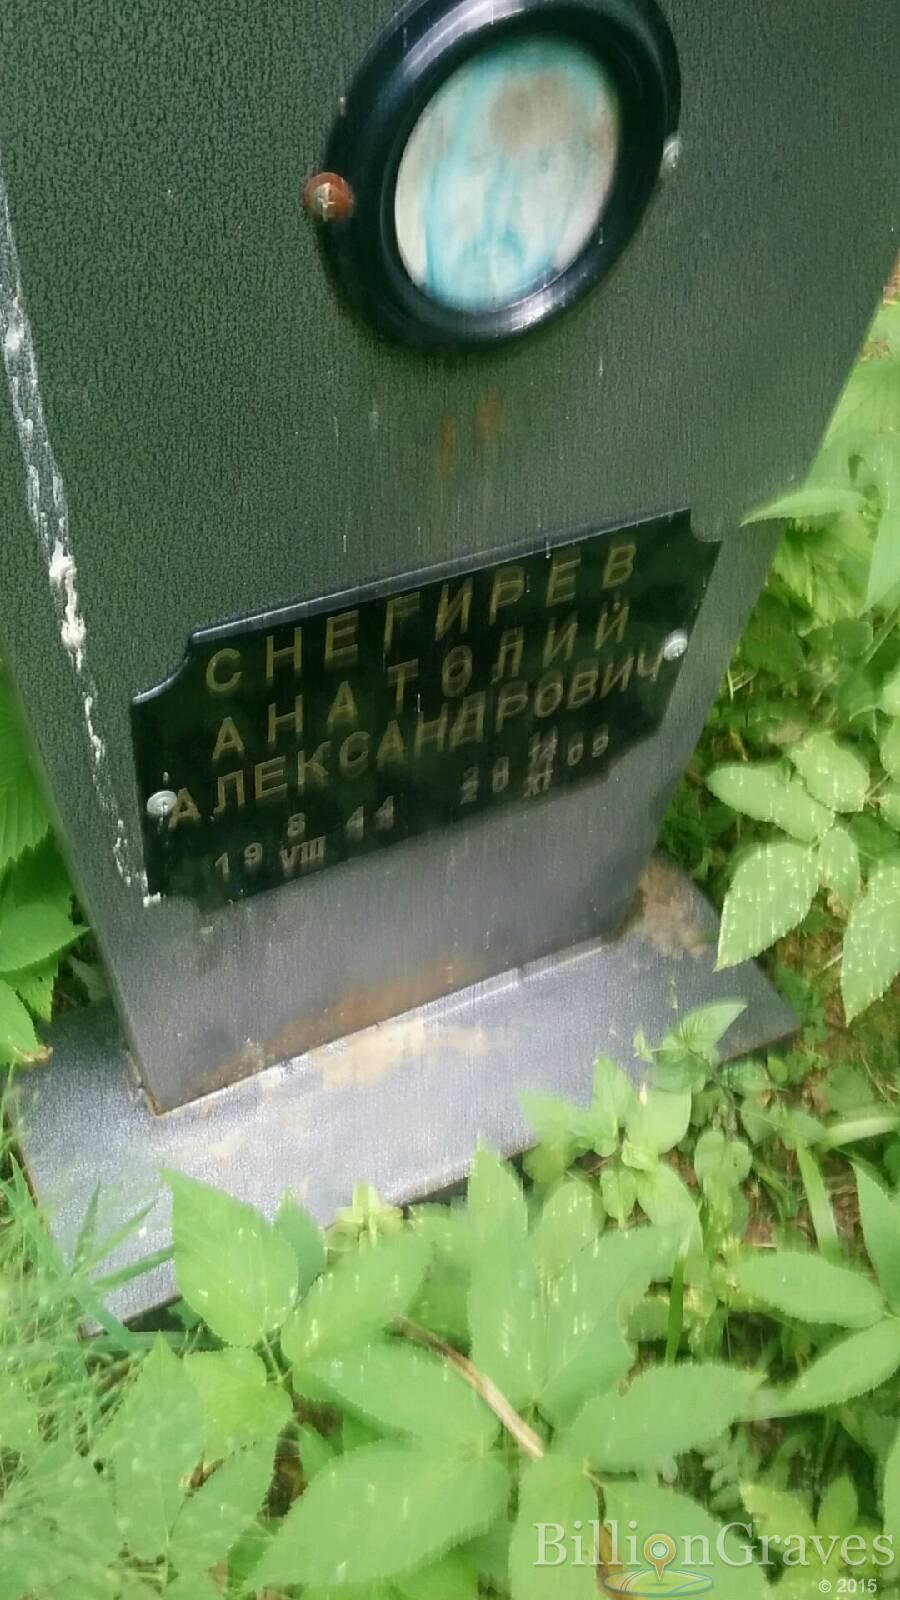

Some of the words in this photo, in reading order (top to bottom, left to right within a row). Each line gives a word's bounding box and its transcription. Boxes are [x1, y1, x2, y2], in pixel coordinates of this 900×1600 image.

[206, 540, 636, 693] СНЕГИРЕВ
[212, 594, 629, 761] АНАТОЛИЙ
[168, 648, 664, 830] АЛЕКСАНДРОВИЧ
